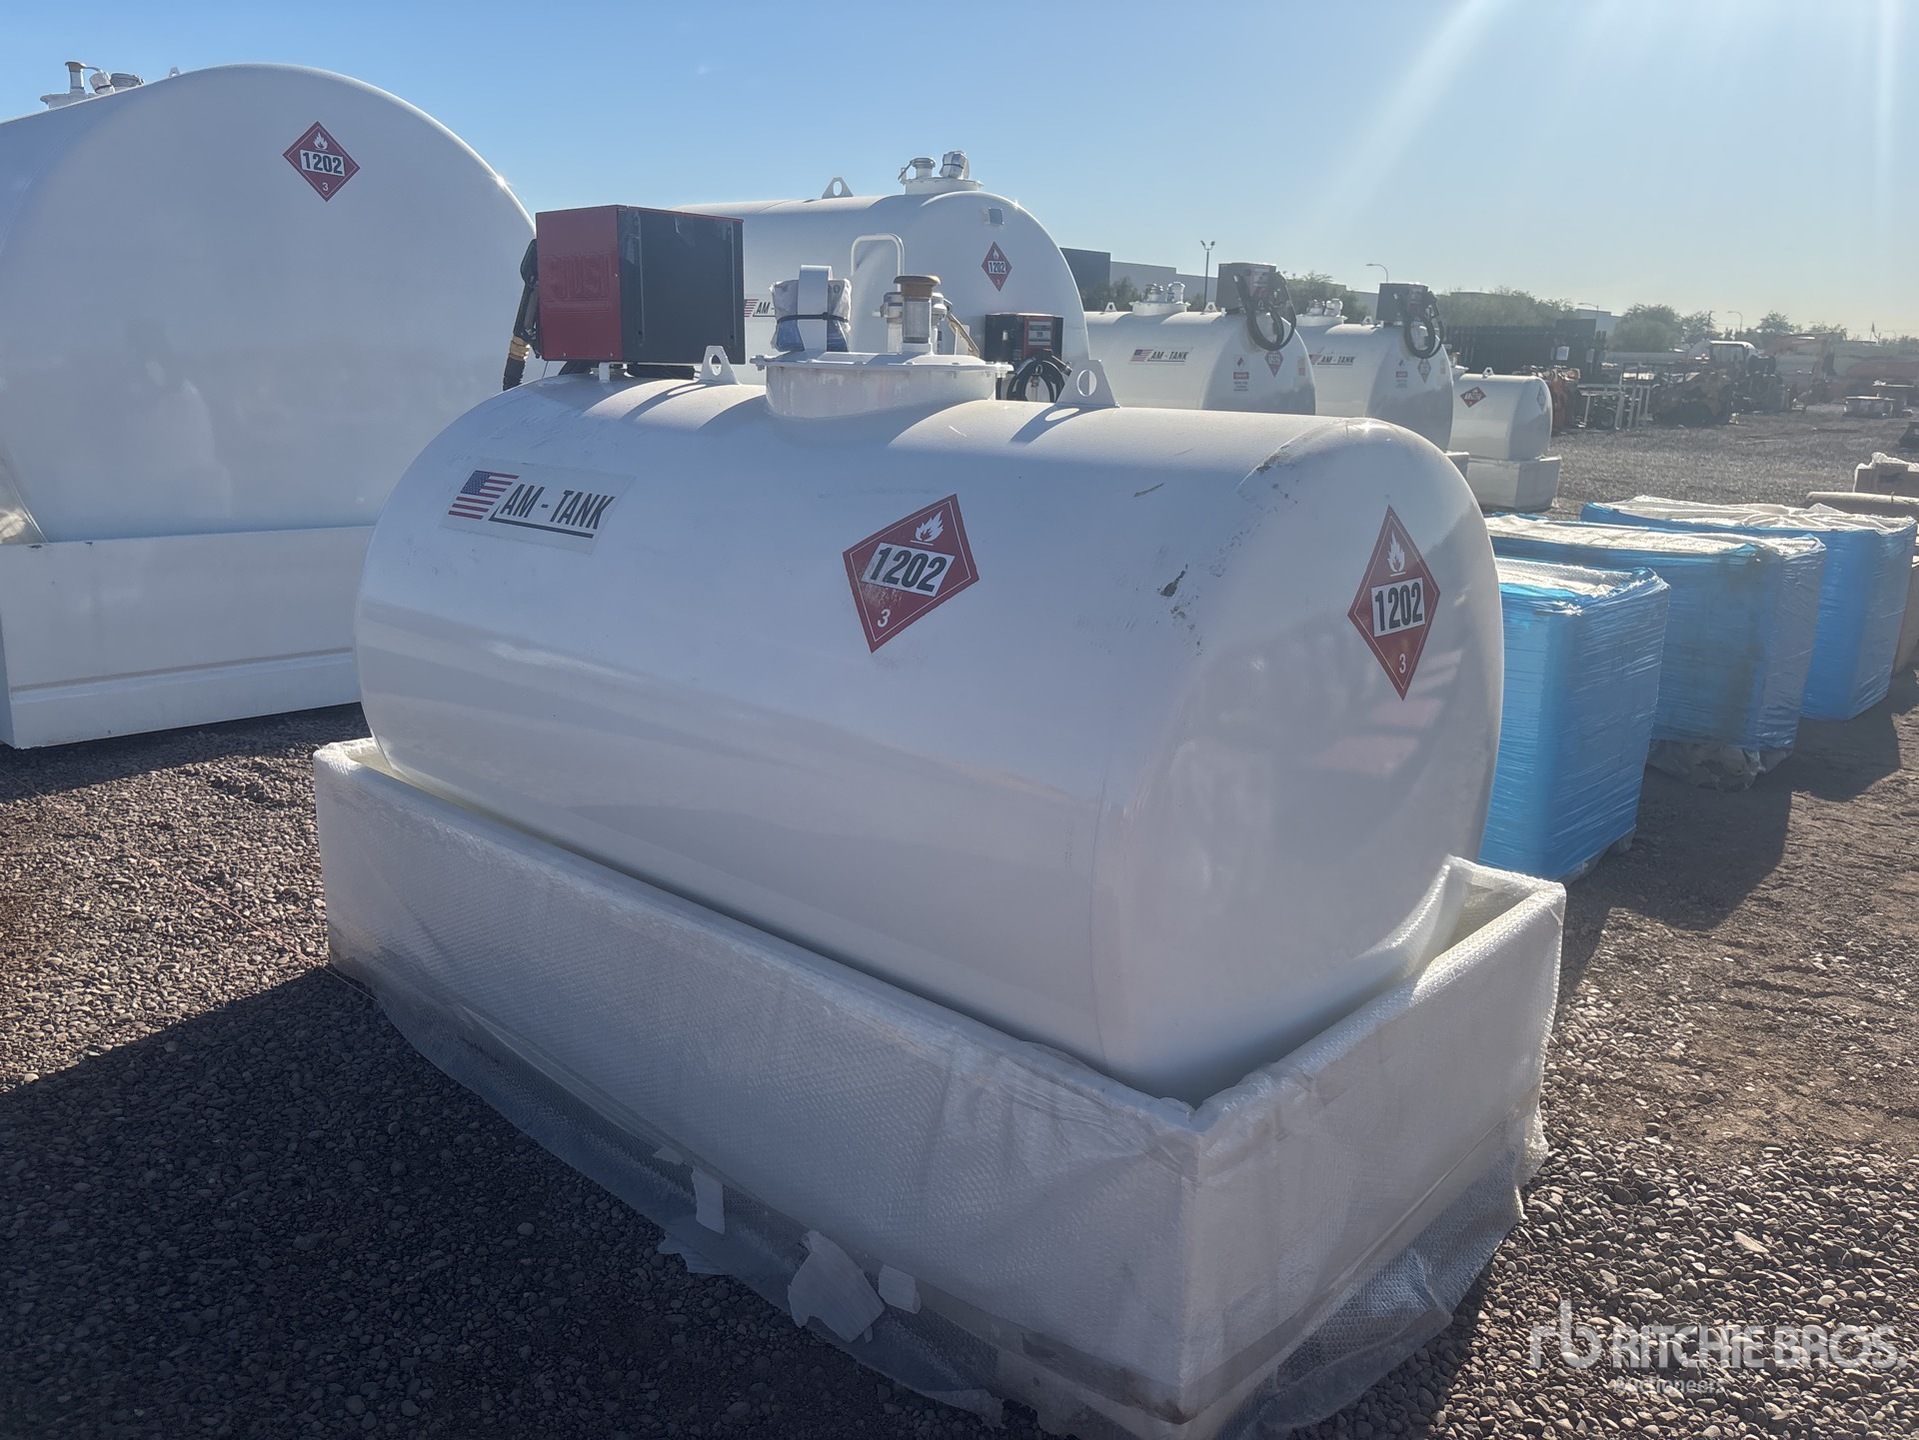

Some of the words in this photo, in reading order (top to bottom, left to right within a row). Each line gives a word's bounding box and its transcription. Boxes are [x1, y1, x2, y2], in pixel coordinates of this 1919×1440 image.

[302, 152, 343, 174] 1202
[322, 182, 329, 191] 3
[756, 302, 770, 314] AM
[1150, 351, 1164, 360] AM
[1169, 351, 1189, 360] TANK
[500, 484, 545, 518] AM
[550, 490, 616, 530] TANK
[870, 547, 947, 592] 1202
[1375, 582, 1423, 631] 1202
[877, 608, 891, 627] 3
[1399, 653, 1407, 673] 3
